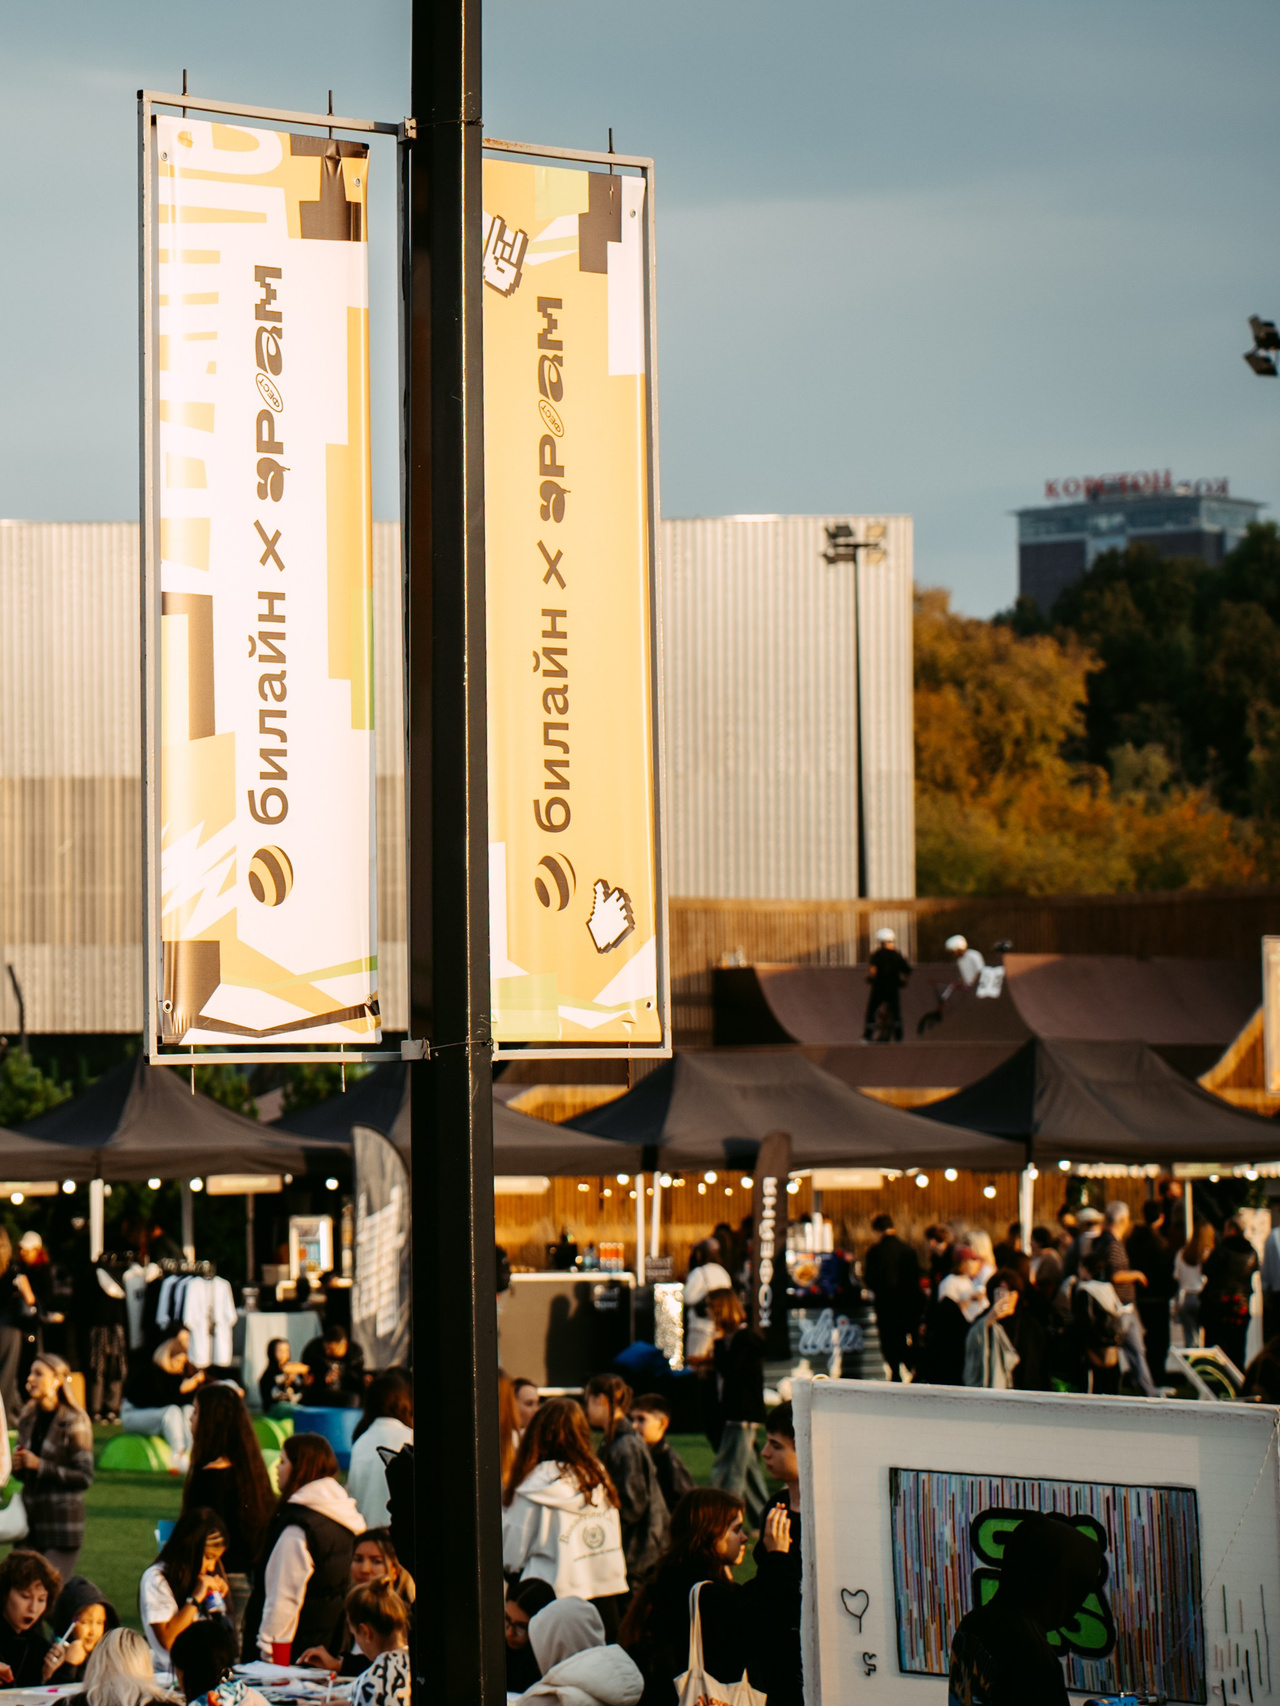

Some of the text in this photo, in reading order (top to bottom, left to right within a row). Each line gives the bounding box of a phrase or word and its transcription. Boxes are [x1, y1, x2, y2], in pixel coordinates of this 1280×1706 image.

[258, 377, 280, 408] ФЕСТ
[540, 404, 561, 433] ФЕСТ
[247, 591, 289, 826] билайн
[533, 608, 572, 834] билайн
[758, 1176, 779, 1328] КОФЕЙНЯ
